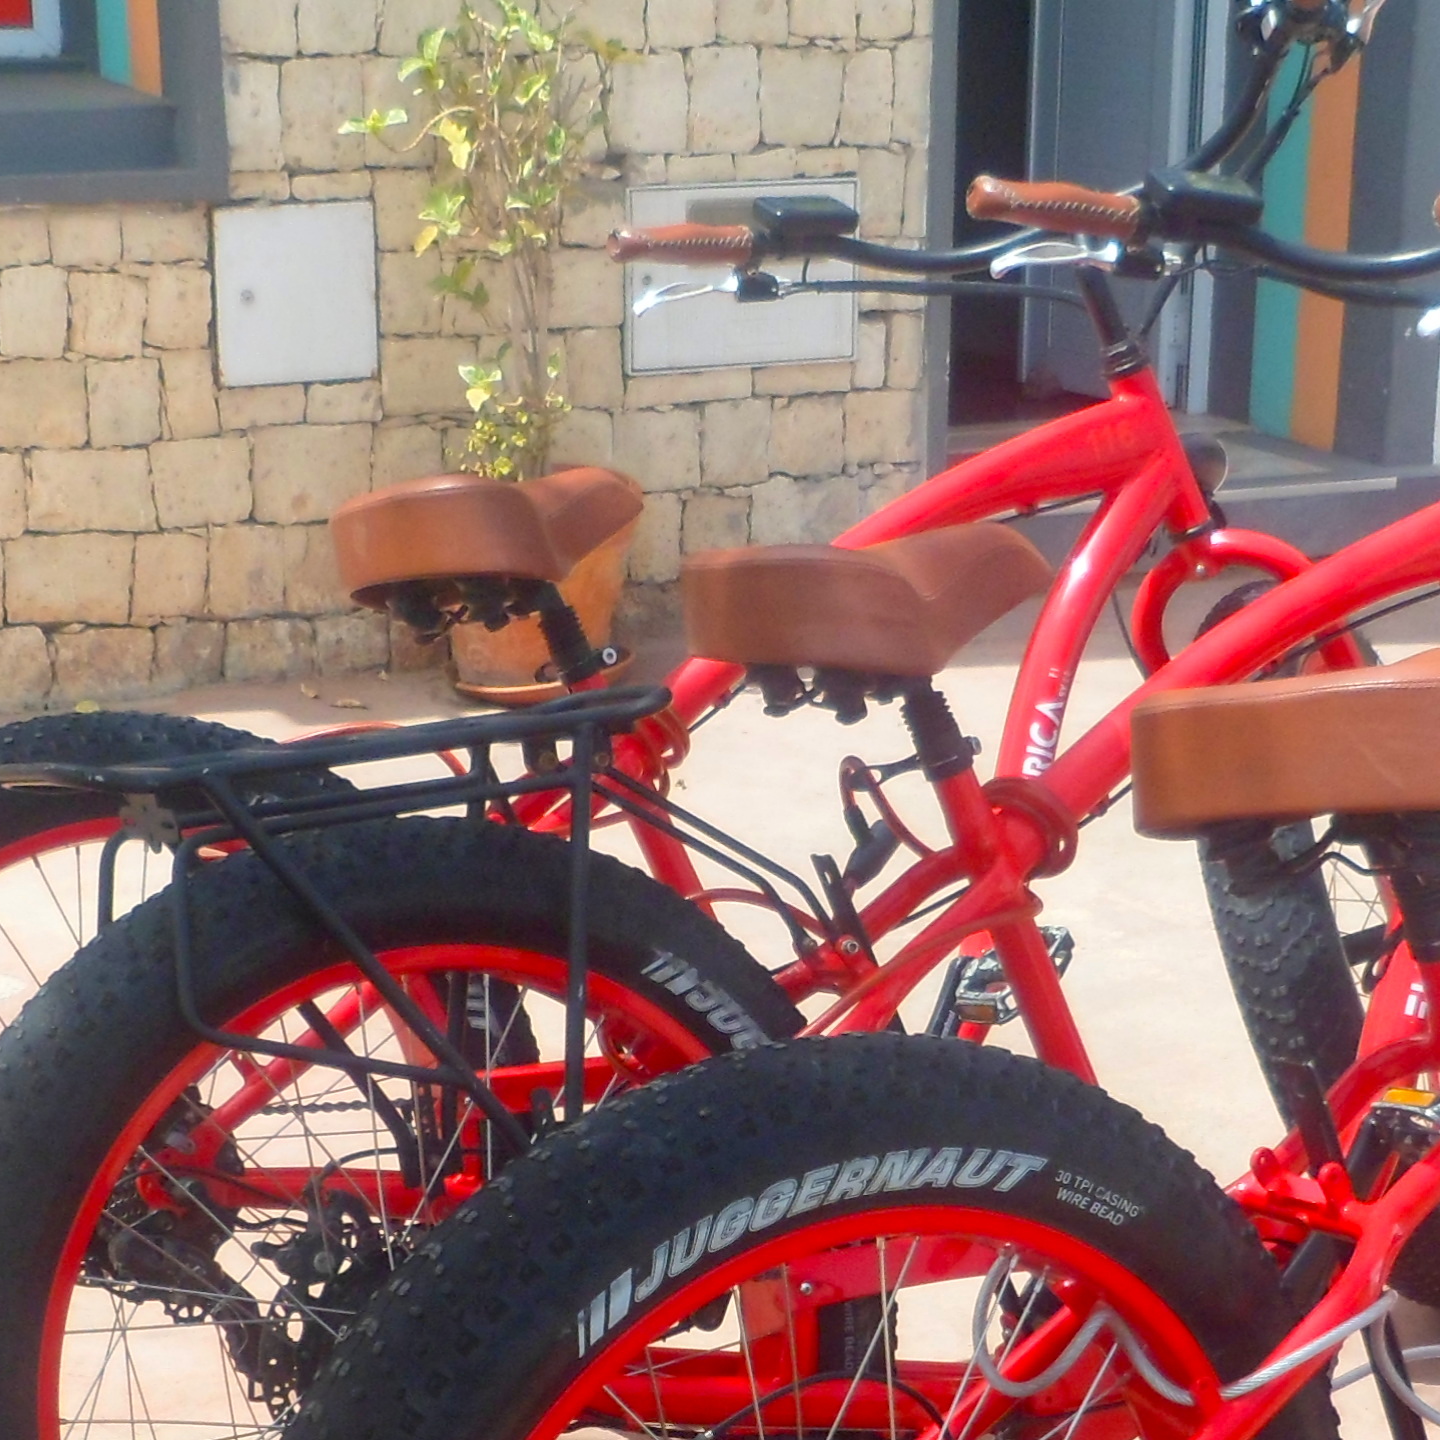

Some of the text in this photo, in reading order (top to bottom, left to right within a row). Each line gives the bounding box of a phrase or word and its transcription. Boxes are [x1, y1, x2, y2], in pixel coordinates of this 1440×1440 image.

[1055, 1171, 1139, 1217] 30 TPI CASING
[1057, 1187, 1124, 1225] WIRE BEAD
[634, 1146, 1049, 1304] JUGGERNAUT
